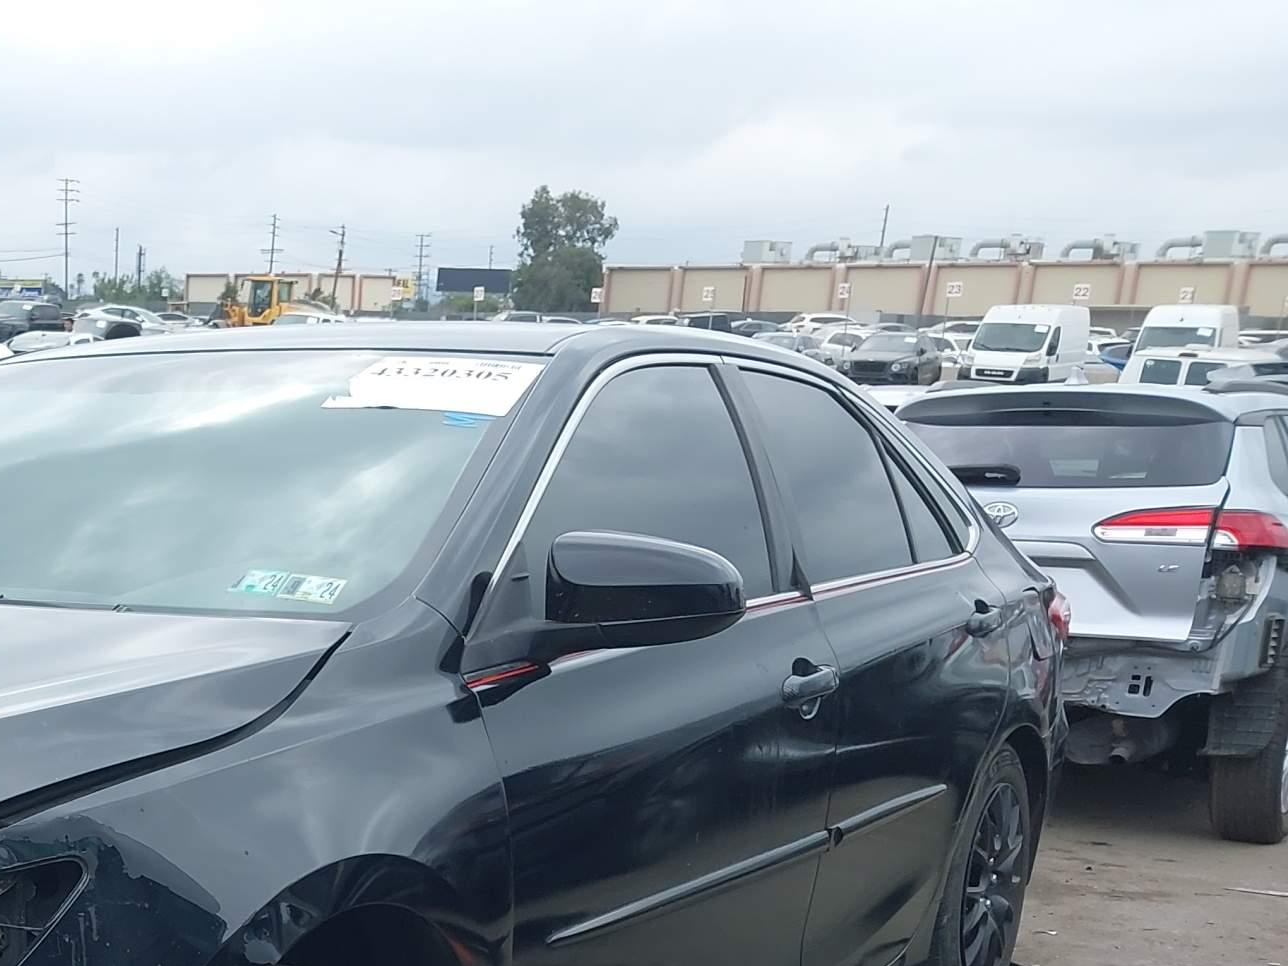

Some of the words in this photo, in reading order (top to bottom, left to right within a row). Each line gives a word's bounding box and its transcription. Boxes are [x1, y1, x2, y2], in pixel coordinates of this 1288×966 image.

[947, 284, 961, 295] 23
[1073, 287, 1089, 297] 22
[371, 366, 513, 382] 43320305
[263, 574, 284, 592] 24
[319, 581, 341, 600] 24
